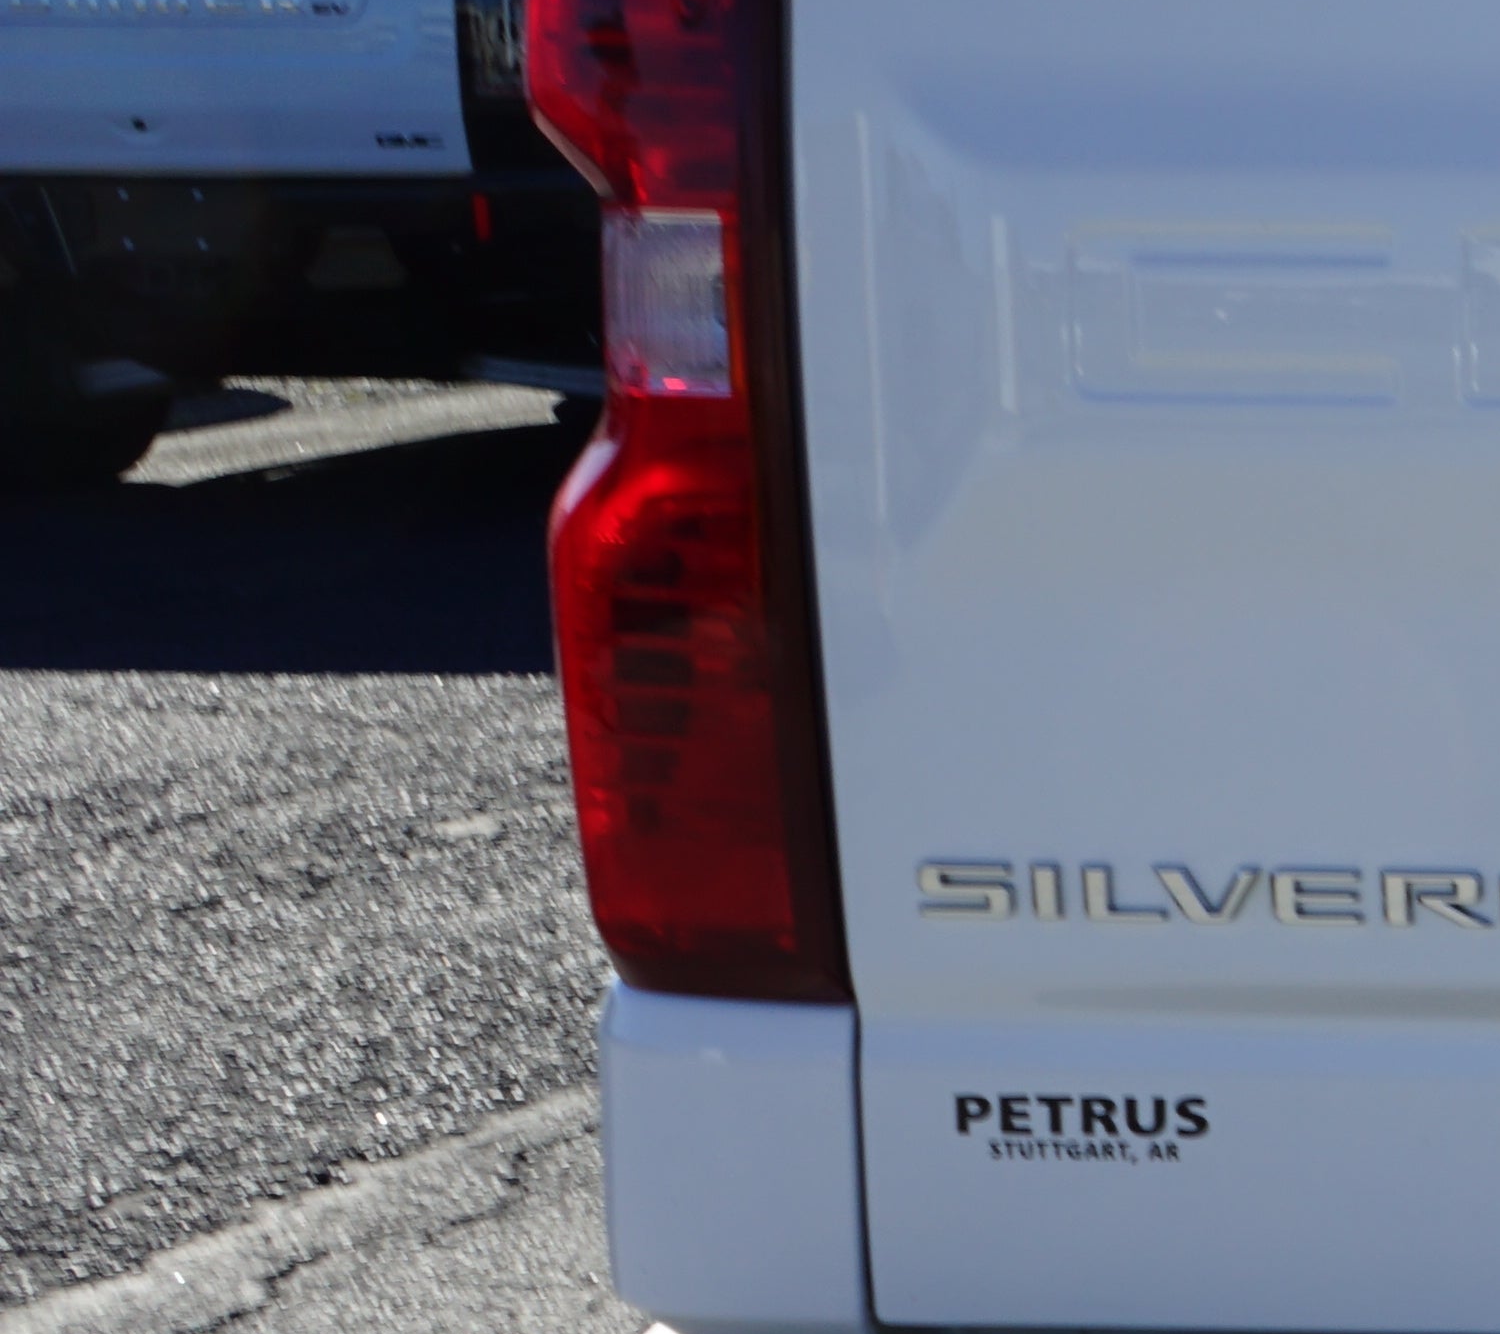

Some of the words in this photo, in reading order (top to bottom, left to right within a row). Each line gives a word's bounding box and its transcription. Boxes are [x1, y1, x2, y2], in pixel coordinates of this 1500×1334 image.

[954, 1095, 1210, 1136] PETRUS
[988, 1141, 1138, 1165] STUTTGART,
[1151, 1142, 1180, 1162] AR
